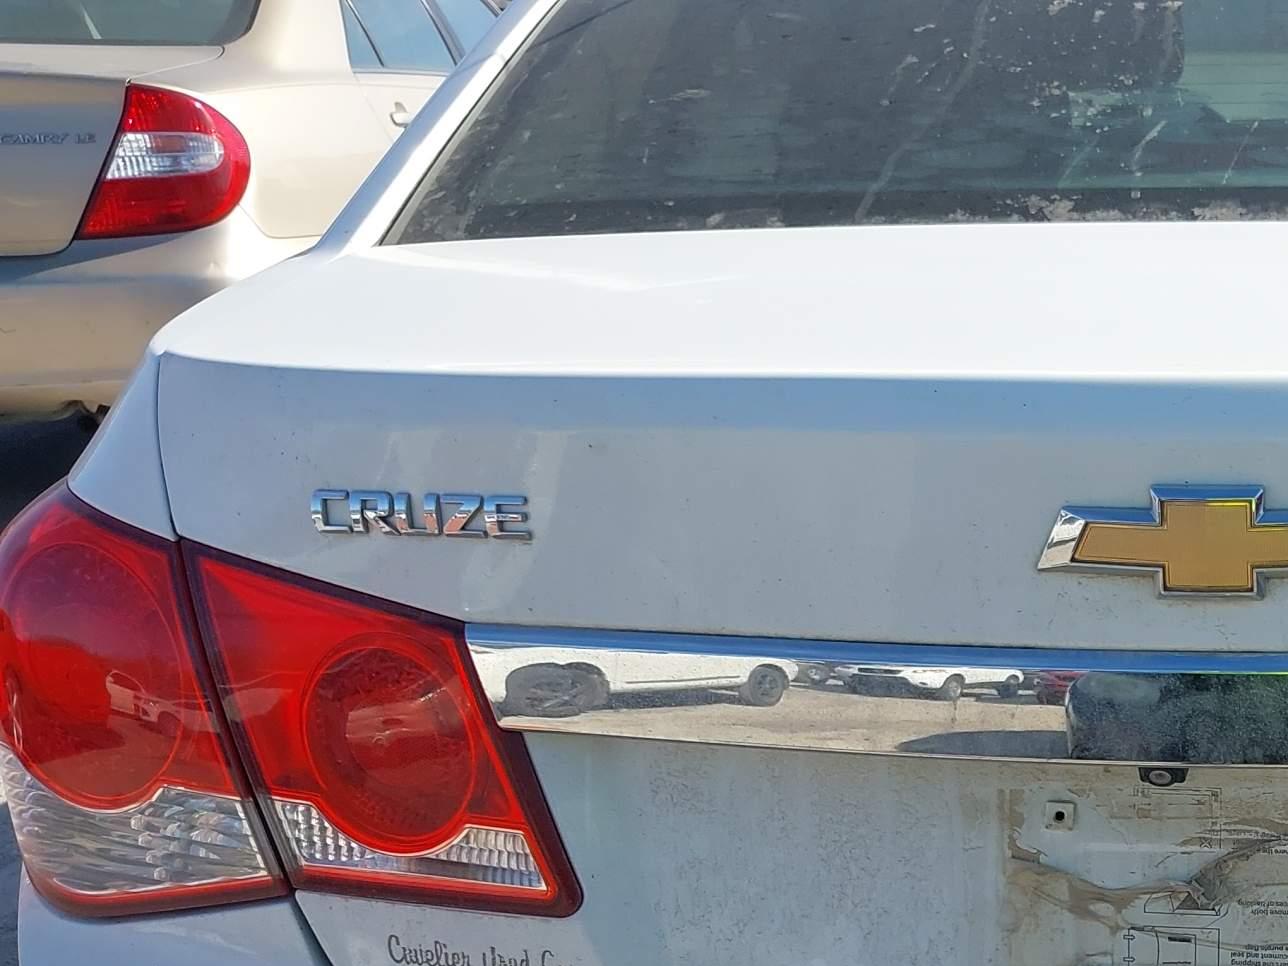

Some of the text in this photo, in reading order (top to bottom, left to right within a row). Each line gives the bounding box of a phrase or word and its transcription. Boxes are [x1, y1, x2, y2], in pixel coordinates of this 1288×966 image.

[0, 133, 69, 145] CAMRY
[311, 489, 531, 538] CRUZE
[1230, 958, 1261, 966] shipping
